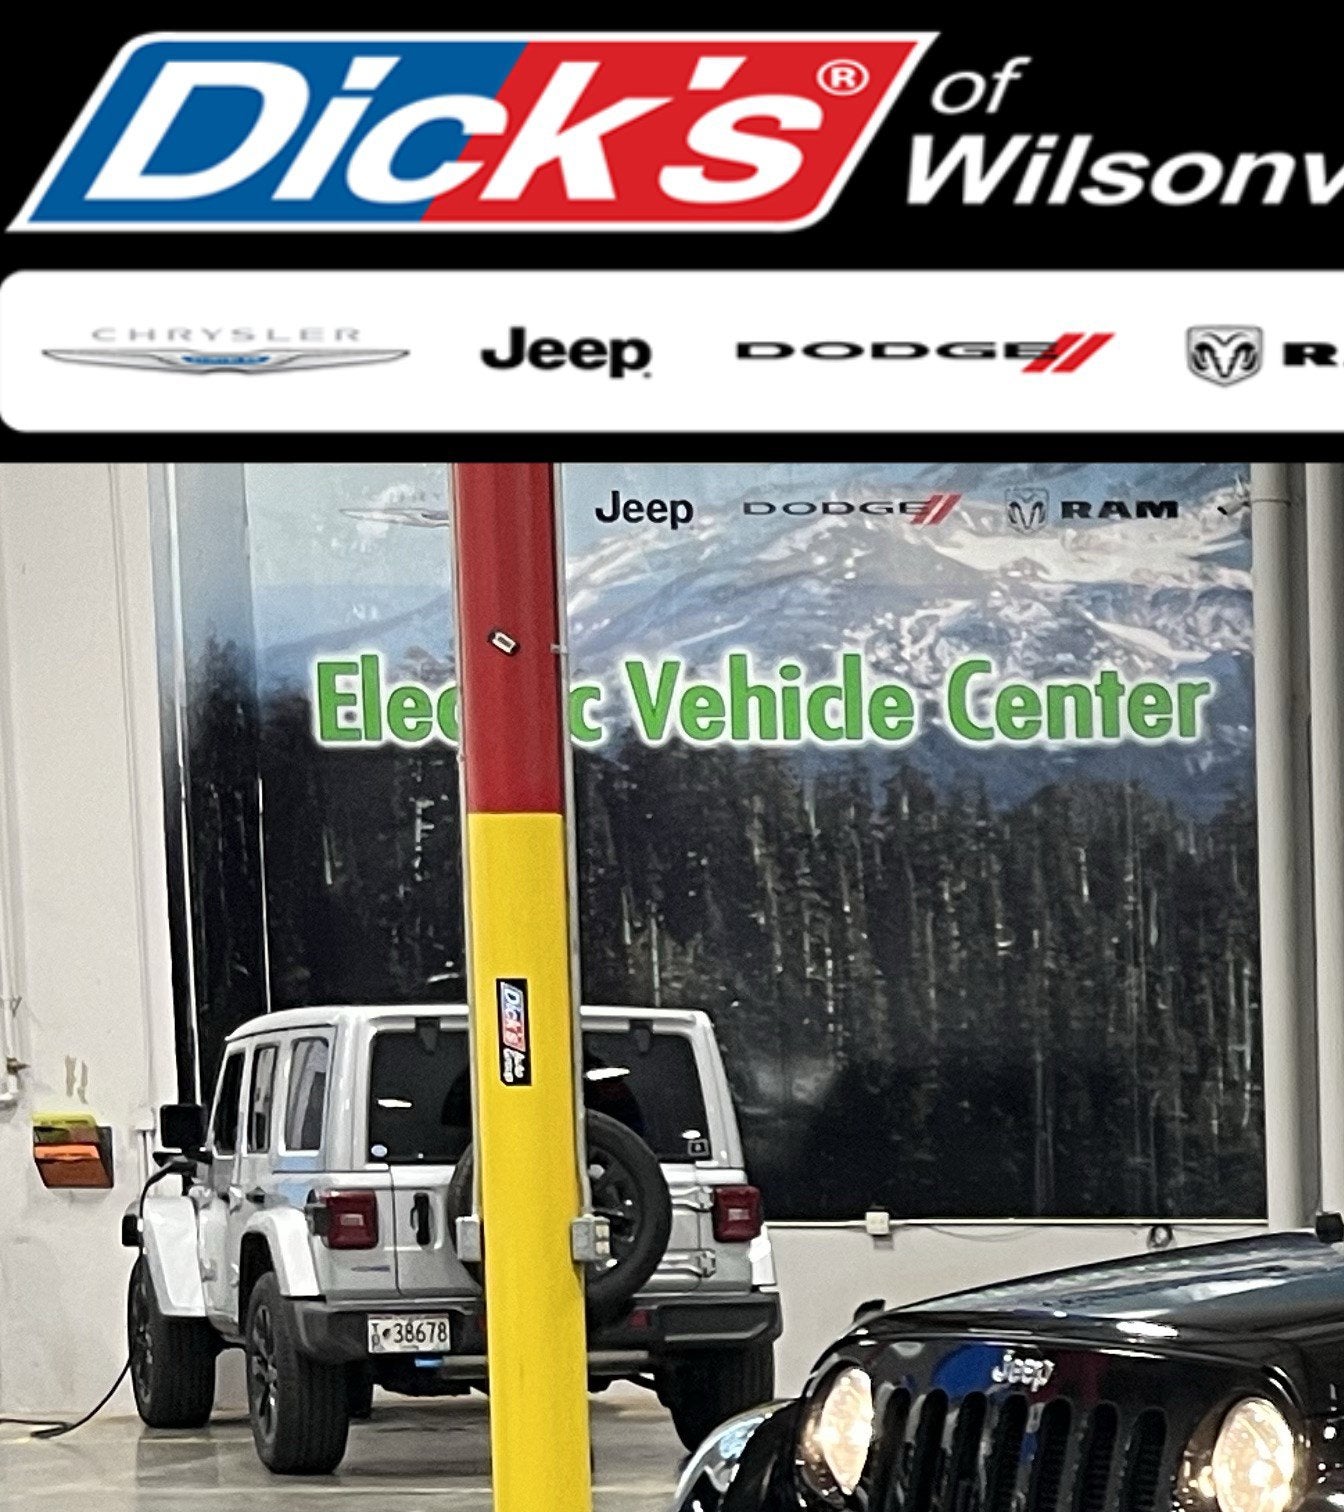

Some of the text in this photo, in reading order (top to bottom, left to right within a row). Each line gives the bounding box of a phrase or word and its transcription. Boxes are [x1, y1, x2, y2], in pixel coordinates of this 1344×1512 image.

[595, 490, 694, 531] Jeep
[743, 500, 930, 517] DODGE
[1060, 500, 1179, 520] RAM
[317, 653, 1211, 742] Elecc Vehicle Center
